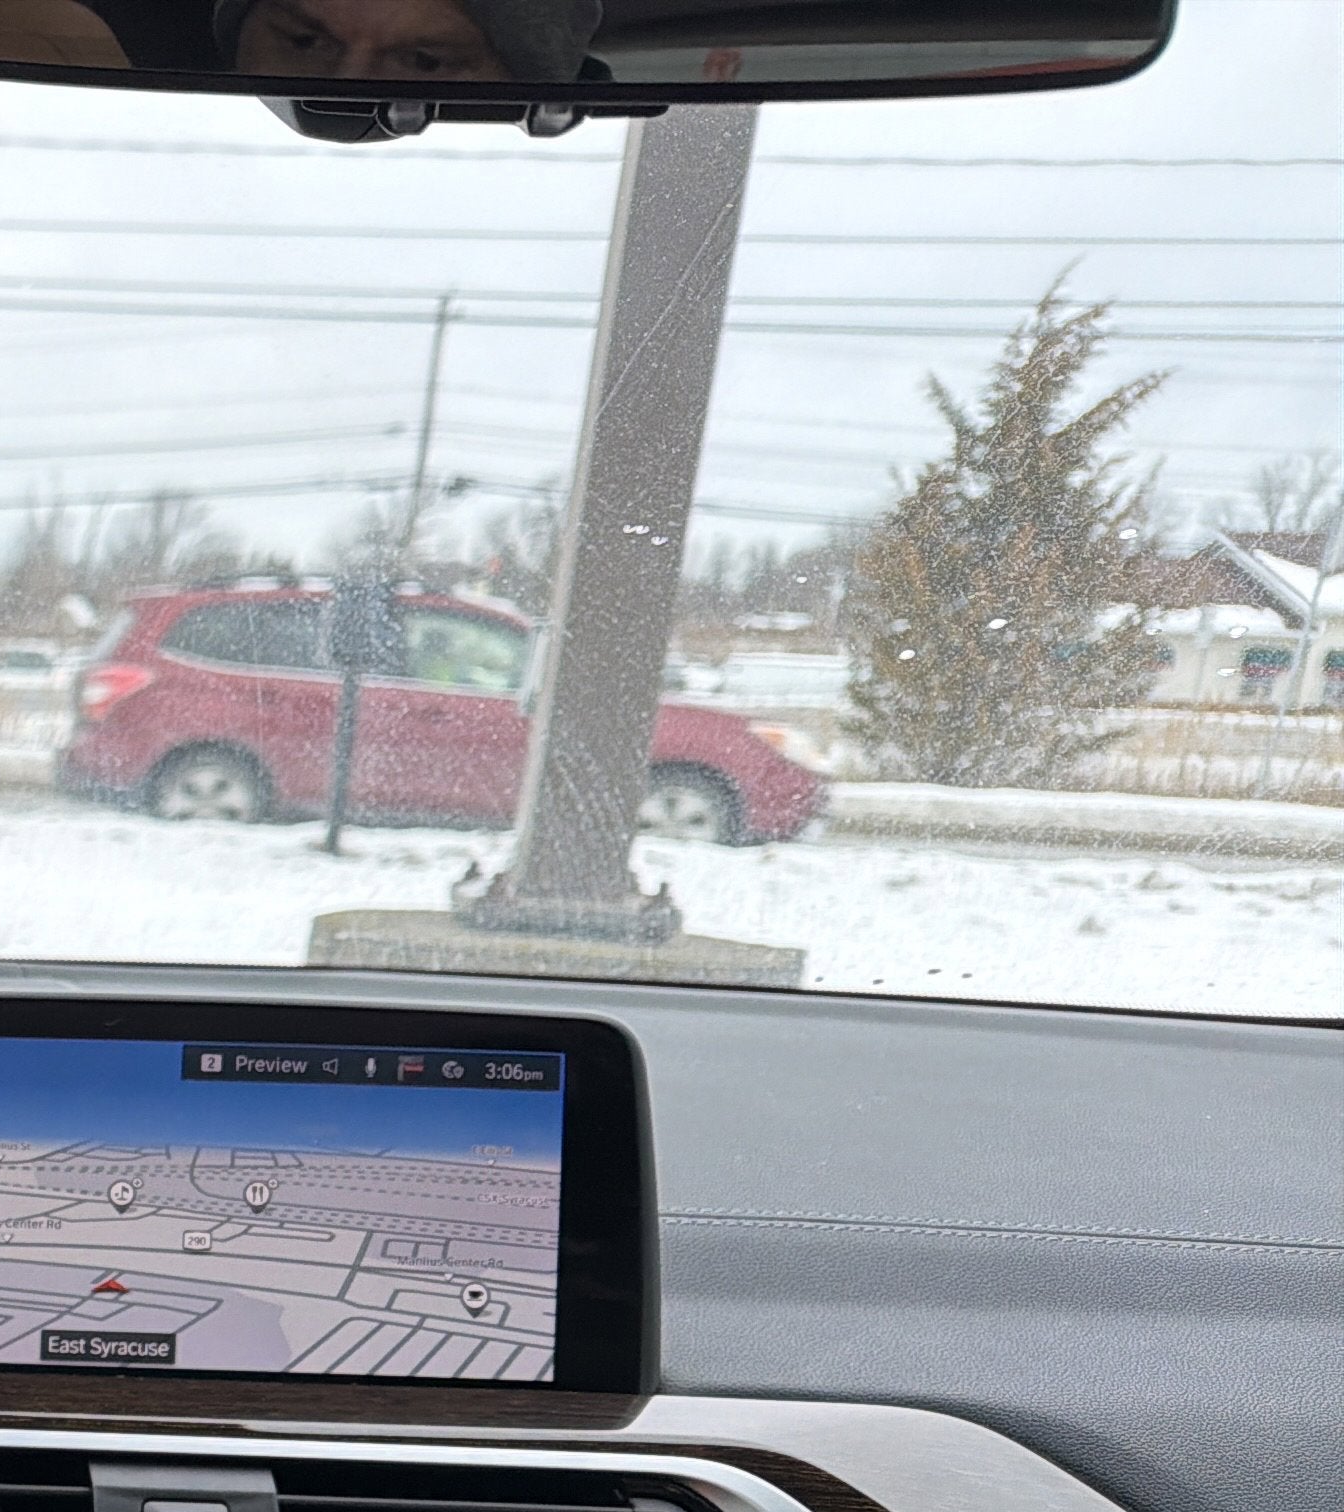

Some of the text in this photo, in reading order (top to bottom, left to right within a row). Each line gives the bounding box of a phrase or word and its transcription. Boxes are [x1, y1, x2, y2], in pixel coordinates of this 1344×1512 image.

[235, 1056, 307, 1074] Preview
[484, 1062, 543, 1082] 3:06pm
[4, 1217, 42, 1230] Center
[45, 1218, 62, 1231] Rd
[187, 1235, 207, 1247] 290
[48, 1337, 170, 1359] East Syracuse
